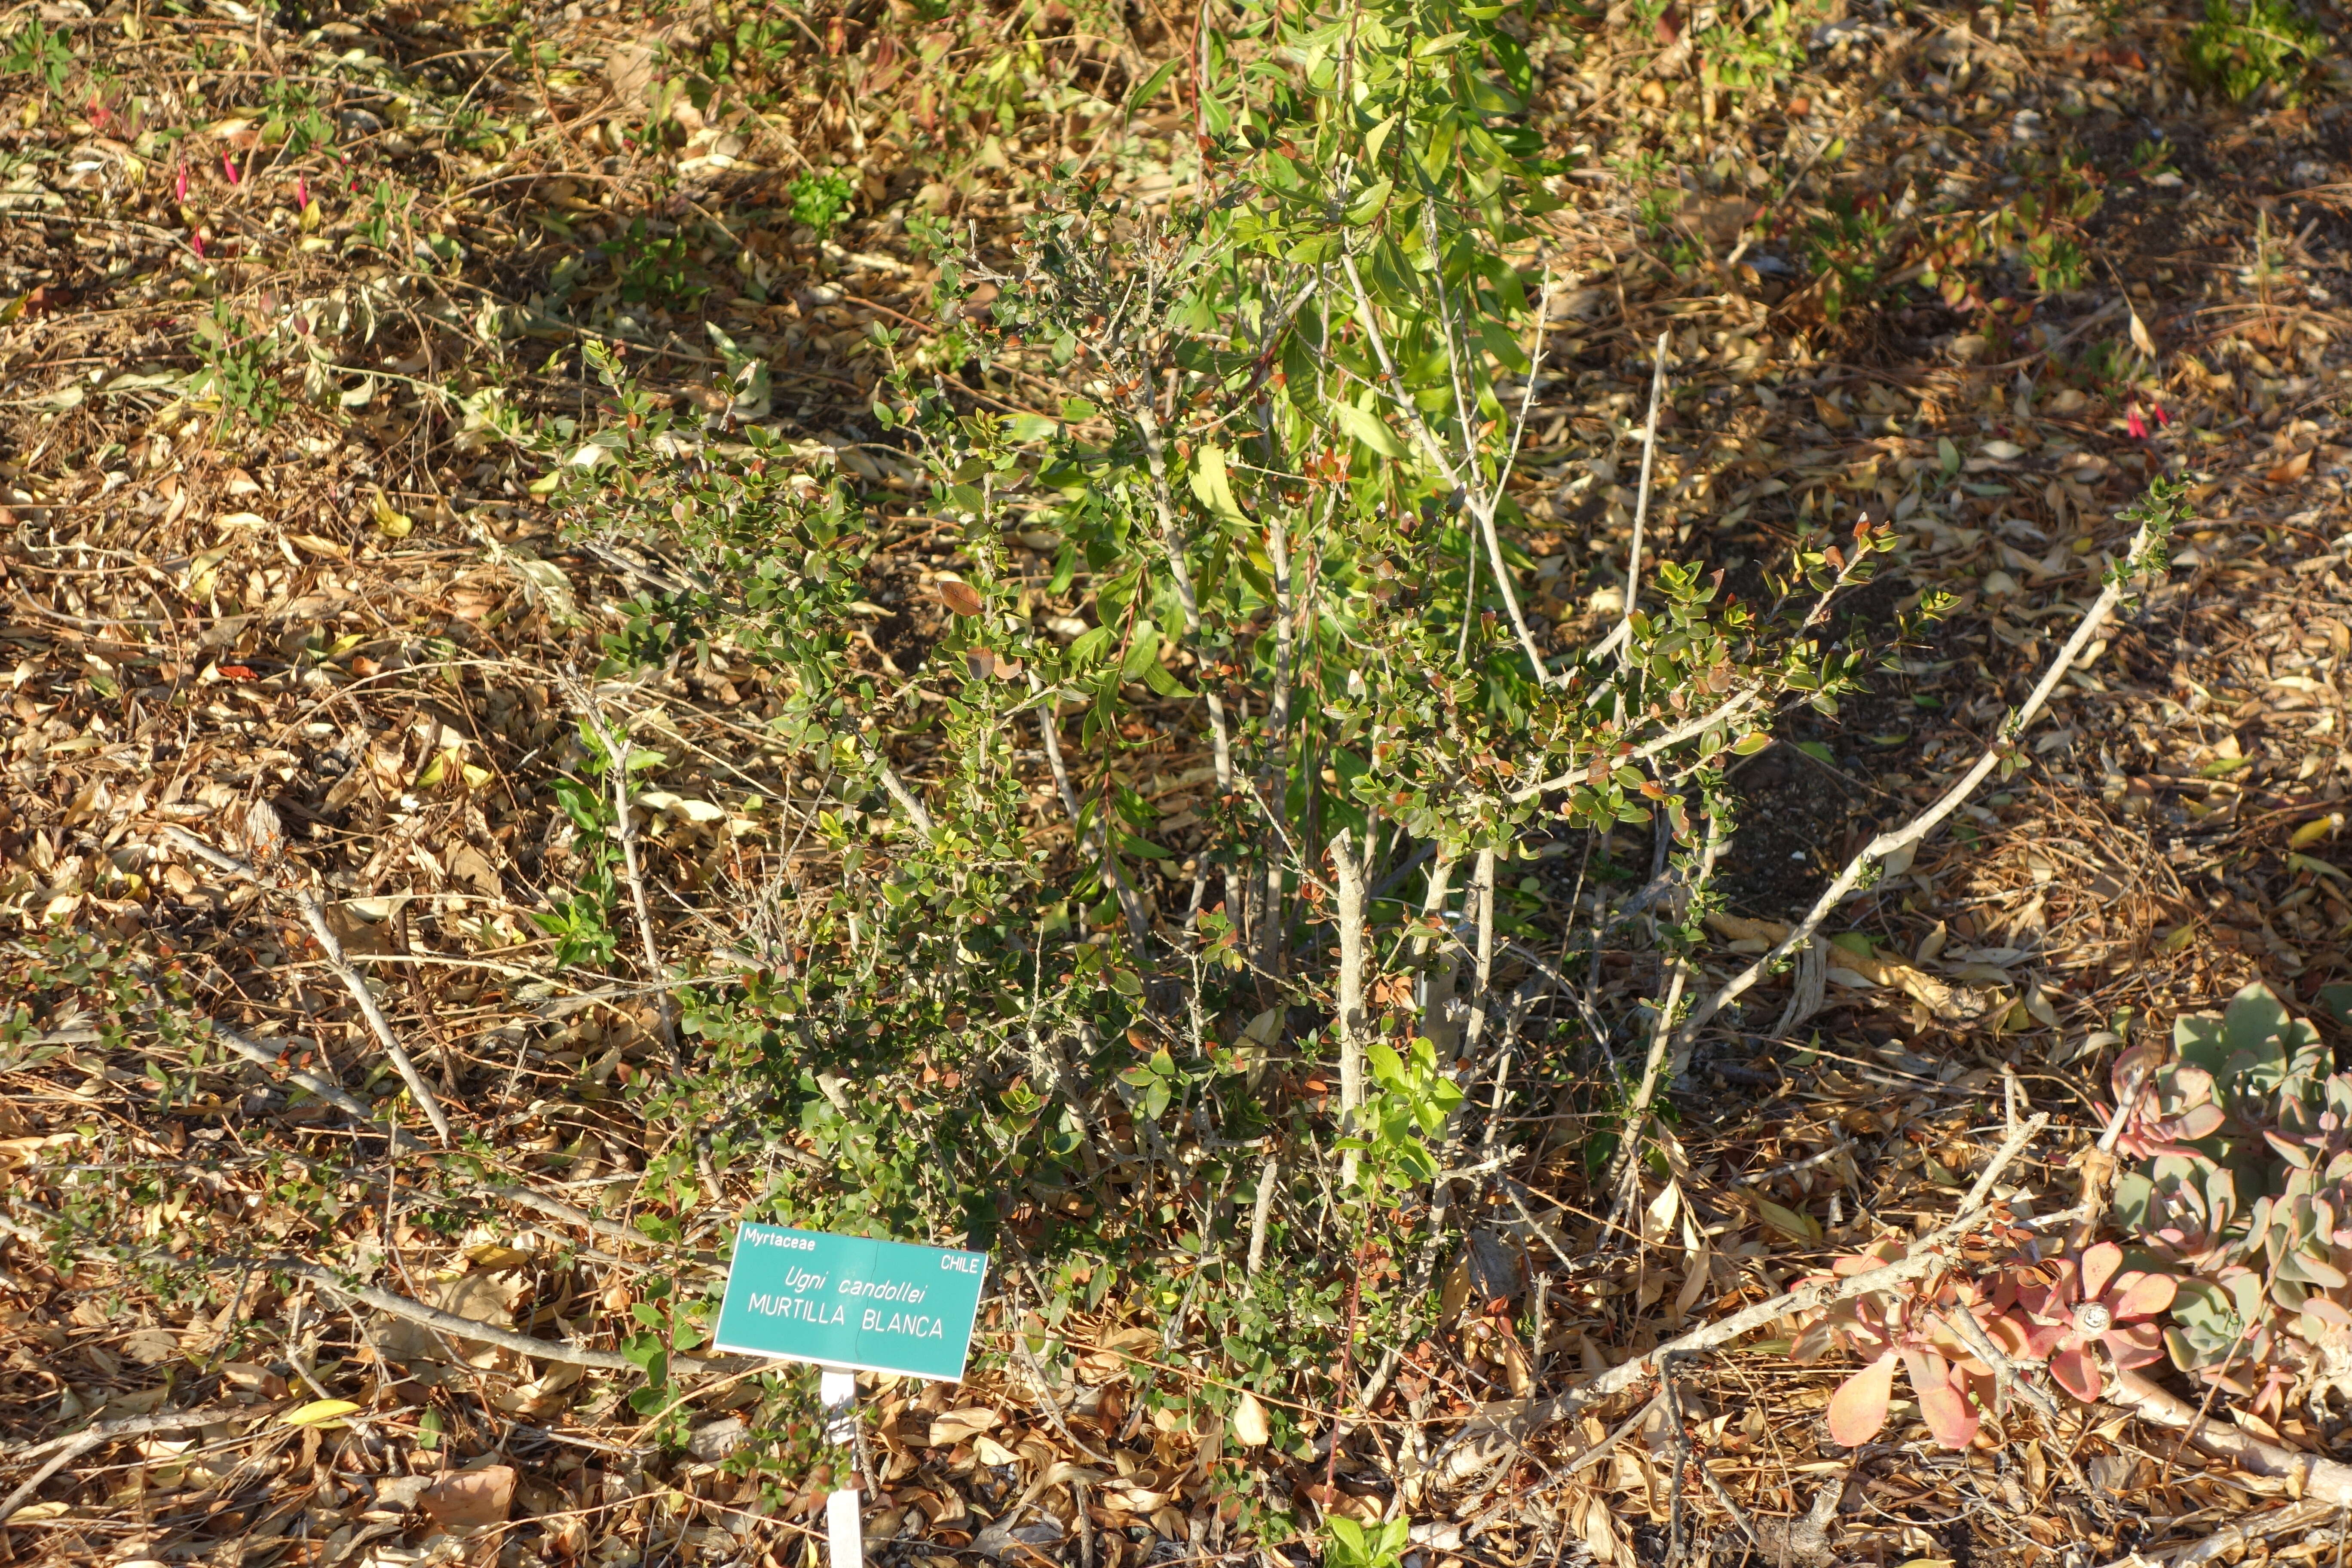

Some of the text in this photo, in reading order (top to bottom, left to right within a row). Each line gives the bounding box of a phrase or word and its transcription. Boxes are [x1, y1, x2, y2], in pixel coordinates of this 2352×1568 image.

[744, 1228, 815, 1251] Myrtaceae
[941, 1255, 980, 1274] CHILE
[785, 1266, 928, 1304] Ugni candollei
[748, 1293, 942, 1339] MURTILLA BLANCA
